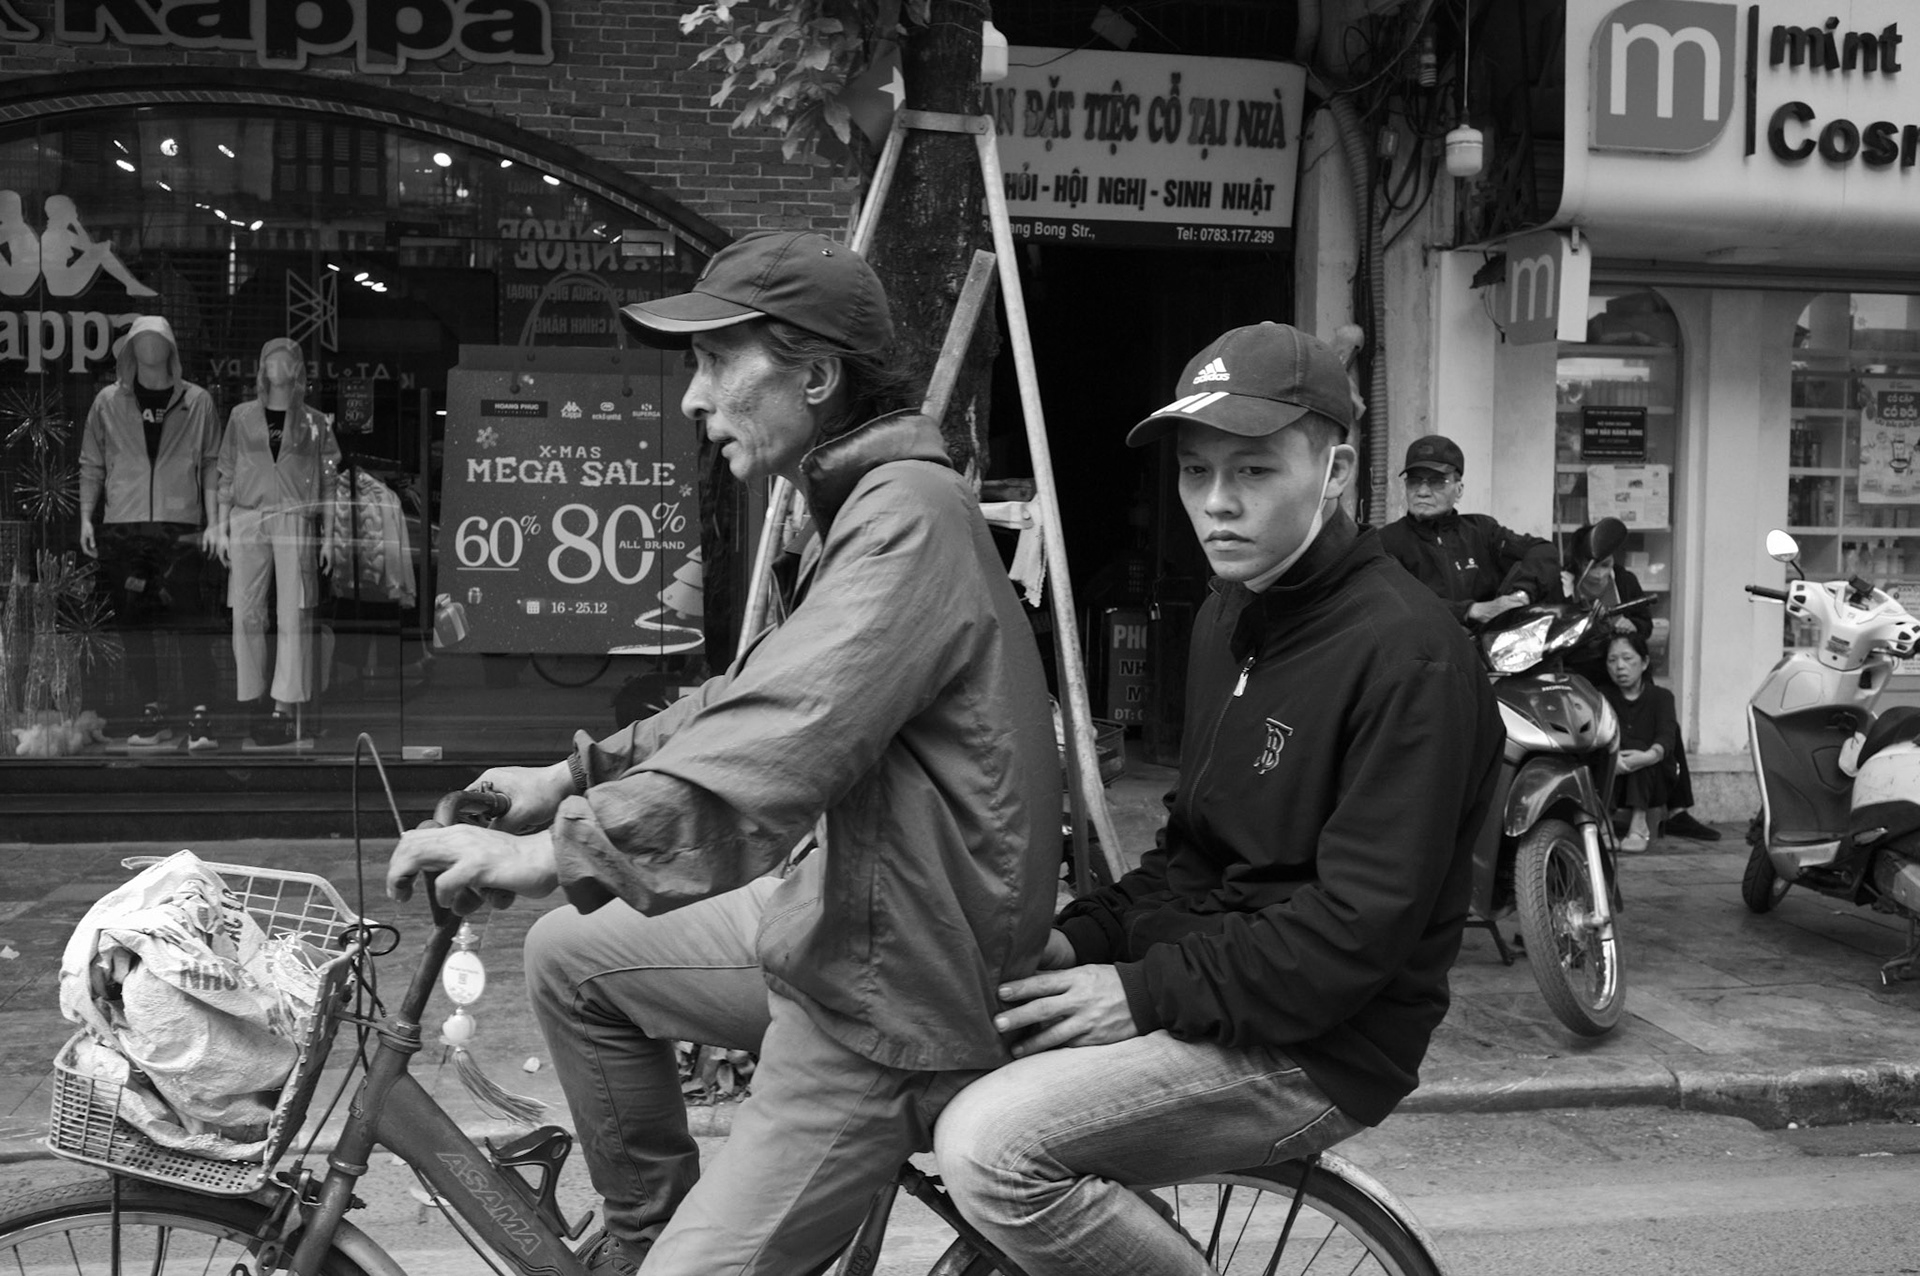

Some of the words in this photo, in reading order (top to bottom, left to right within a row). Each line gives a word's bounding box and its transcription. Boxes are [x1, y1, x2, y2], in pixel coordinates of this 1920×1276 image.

[1770, 16, 1902, 73] mint
[1083, 79, 1141, 155] TIỆC
[1187, 96, 1230, 160] TẠI
[1234, 88, 1286, 149] NHÀ
[1053, 167, 1088, 208] HỘI
[1097, 176, 1147, 211] NGHỊ
[1163, 179, 1212, 208] SINH
[1221, 177, 1275, 216] NHẬT
[1034, 221, 1066, 239] Bong
[1177, 226, 1197, 241] Tel:
[1200, 229, 1274, 244] 0783.177.299
[1192, 372, 1231, 385] adidas
[539, 445, 602, 459] X-MAS
[466, 456, 568, 484] MEGA
[579, 460, 676, 487] SALE
[455, 514, 541, 568] 60%
[619, 540, 641, 550] ALL
[644, 540, 686, 550] BRAND
[551, 602, 565, 614] 16
[575, 602, 608, 614] 25.12
[436, 1153, 542, 1256] ASAMA
